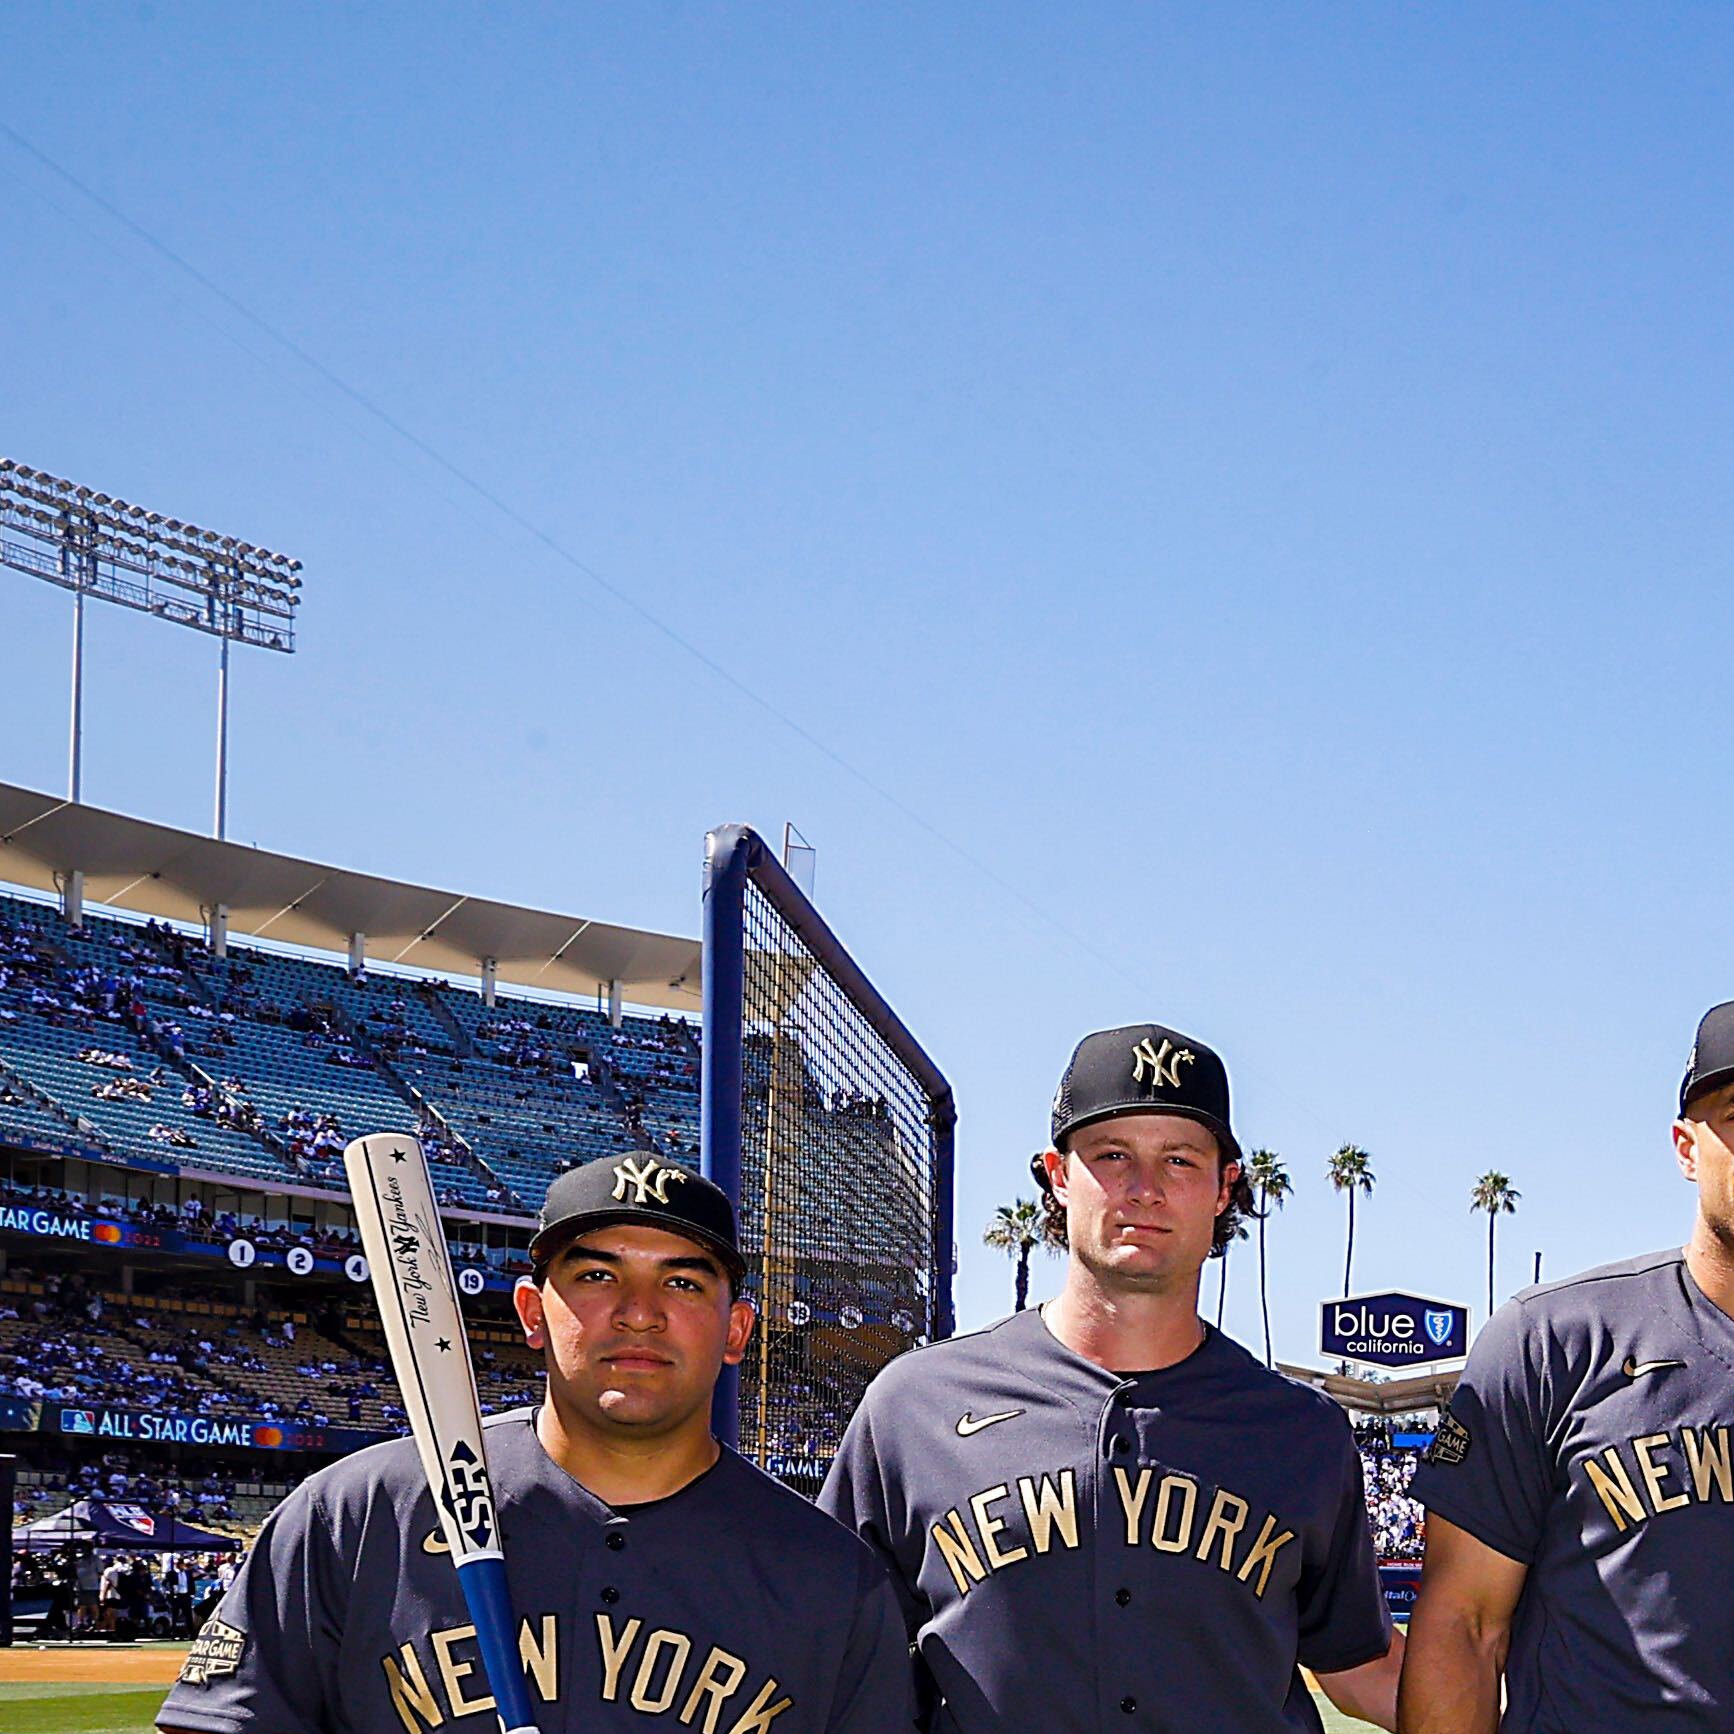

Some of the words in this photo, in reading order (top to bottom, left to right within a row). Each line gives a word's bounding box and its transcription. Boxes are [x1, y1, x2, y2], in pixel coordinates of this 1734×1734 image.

[1131, 1037, 1182, 1089] NY
[611, 1157, 671, 1205] NY
[382, 1176, 419, 1236] Yankees
[33, 1210, 91, 1241] GAME
[238, 1245, 246, 1261] 1
[294, 1252, 306, 1269] 2
[351, 1260, 364, 1277] 4
[397, 1254, 433, 1295] York
[463, 1274, 479, 1289] 19
[410, 1293, 431, 1329] New
[1334, 1304, 1415, 1338] blue
[1346, 1339, 1424, 1354] california
[98, 1410, 133, 1438] ALL
[139, 1413, 187, 1443] STAR
[191, 1418, 250, 1446] GAME
[1437, 1428, 1468, 1454] GAME
[766, 1455, 824, 1478] GAME
[1583, 1426, 1734, 1534] NEW
[930, 1469, 1080, 1598] NEW
[1112, 1466, 1296, 1599] YORK
[208, 1639, 241, 1660] GAME
